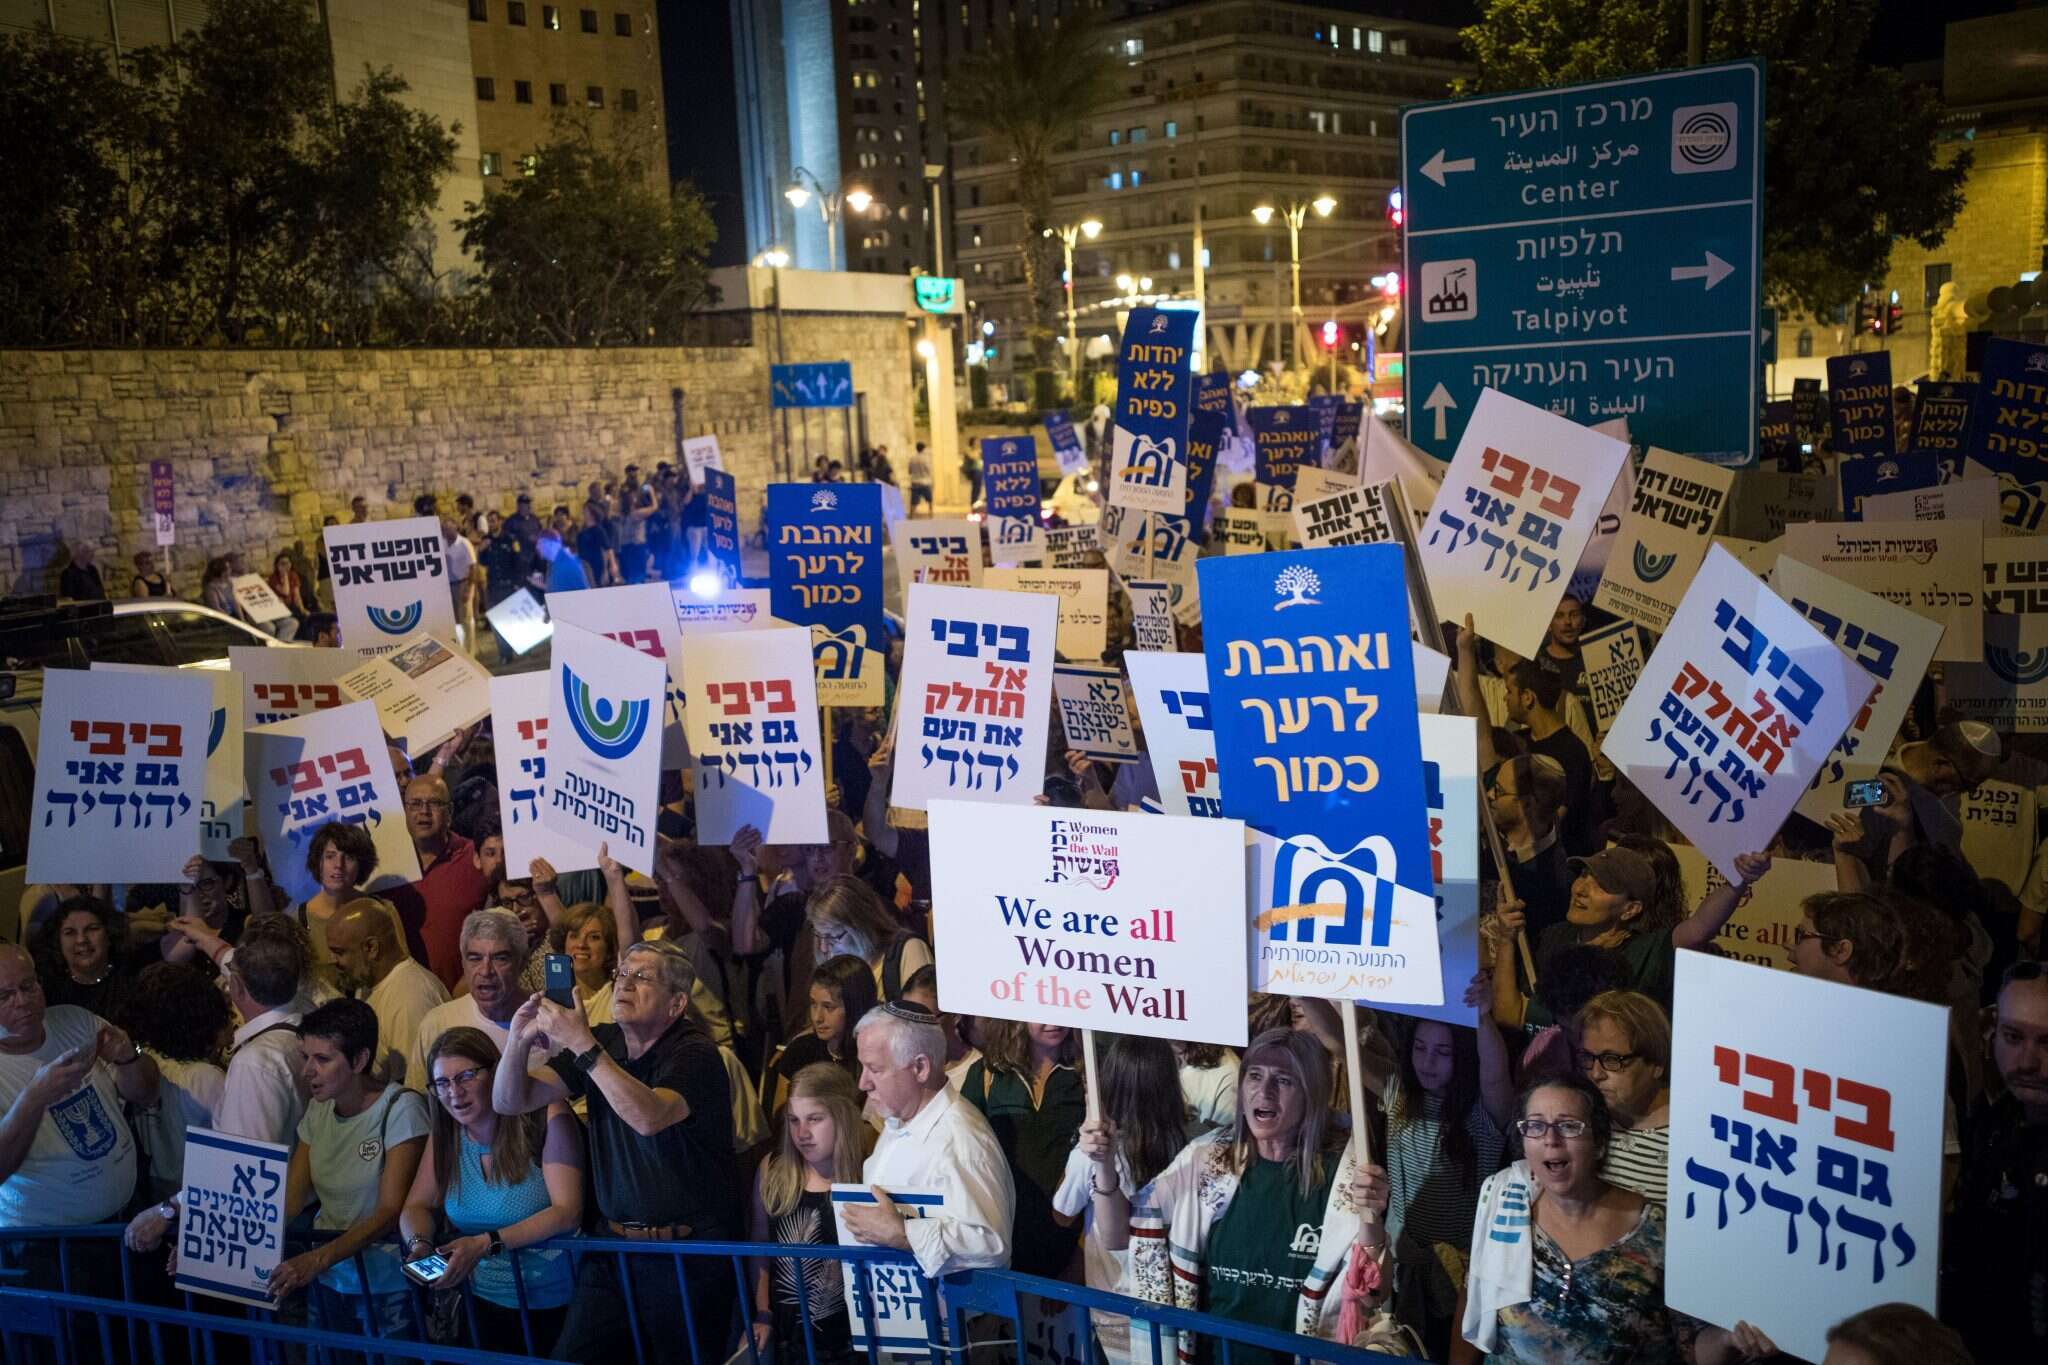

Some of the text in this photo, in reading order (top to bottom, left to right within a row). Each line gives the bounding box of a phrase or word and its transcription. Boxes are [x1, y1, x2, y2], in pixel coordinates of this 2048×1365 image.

[1491, 96, 1653, 138] מרכז העיר
[1504, 140, 1639, 174] مركز المدينة
[1521, 178, 1620, 205] Center
[1516, 228, 1623, 261] תלפיות
[1512, 303, 1628, 333] Talpiyot
[1128, 343, 1184, 364] יהדות
[1134, 370, 1175, 391] ללא
[1473, 356, 1675, 388] העיר העתיקה
[1129, 398, 1177, 419] כפיה
[1588, 395, 1646, 415] البلدة
[1840, 403, 1885, 424] לרעך
[1841, 425, 1885, 443] כמוך
[988, 462, 1035, 476] יהדות
[995, 477, 1031, 492] ללא
[1481, 447, 1581, 520] ביבי
[994, 495, 1036, 509] כפיה
[1638, 467, 1723, 510] חופש דת
[1301, 491, 1359, 523] יותר
[1464, 487, 1515, 528] אני
[1632, 490, 1713, 535] לישראל
[778, 525, 872, 545] ואהבת
[1045, 528, 1096, 544] יש יותר
[1306, 516, 1352, 540] אחת
[1518, 512, 1563, 550] גם
[329, 536, 440, 563] חופש דת
[910, 537, 968, 554] ביבי
[944, 555, 969, 568] אל
[1429, 510, 1560, 592] יהודיה
[333, 554, 443, 586] לישראל
[787, 551, 864, 579] לרעך
[791, 584, 862, 609] כמוך
[1150, 591, 1168, 615] לא
[1921, 582, 1974, 607] כולנו
[1136, 615, 1170, 628] מאמינים
[931, 618, 1030, 663] ביבי
[1224, 631, 1390, 678] ואהבת
[1608, 632, 1635, 663] לא
[985, 662, 1027, 691] אל
[1590, 657, 1640, 685] מאמינים
[1713, 598, 1825, 726] ביבי
[254, 684, 342, 709] ביבי
[706, 680, 796, 716] ביבי
[925, 682, 1024, 718] תחלק
[1088, 678, 1120, 701] לא
[1062, 698, 1124, 715] מאמינים
[1067, 709, 1128, 730] בשנאת
[1241, 687, 1379, 744] לרעך
[1670, 661, 1786, 776] תחלק
[1750, 688, 1801, 749] אל
[70, 720, 183, 757] ביבי
[709, 720, 799, 745] גם אני
[923, 716, 1023, 747] את העם
[1069, 725, 1112, 744] חינם
[1658, 691, 1720, 755] העם
[66, 761, 179, 785] גם אני
[270, 747, 371, 793] ביבי
[699, 749, 812, 790] יהודיה
[922, 744, 1019, 792] יהודי
[1253, 754, 1380, 802] כמוך
[1645, 717, 1745, 823] יהודי
[1718, 749, 1767, 799] את
[45, 789, 191, 829] יהודיה
[278, 781, 378, 821] גם אני
[564, 771, 635, 818] התנועה
[552, 788, 645, 848] הרפורמית
[1069, 821, 1118, 836] Women
[1070, 843, 1118, 856] the Wall
[1071, 832, 1084, 842] of
[994, 895, 1177, 943] We are all
[1757, 921, 1788, 945] all
[1015, 935, 1157, 980] Women
[1262, 946, 1406, 969] התנועה המסורתית
[990, 971, 1189, 1021] of the Wall
[1714, 1044, 1895, 1153] ביבי
[1710, 1113, 1893, 1207] גם אני
[232, 1160, 280, 1200] לא
[187, 1185, 278, 1223] מאמינים
[185, 1206, 276, 1250] בשנאת
[1685, 1156, 1916, 1285] יהודיה
[184, 1232, 247, 1270] חינם
